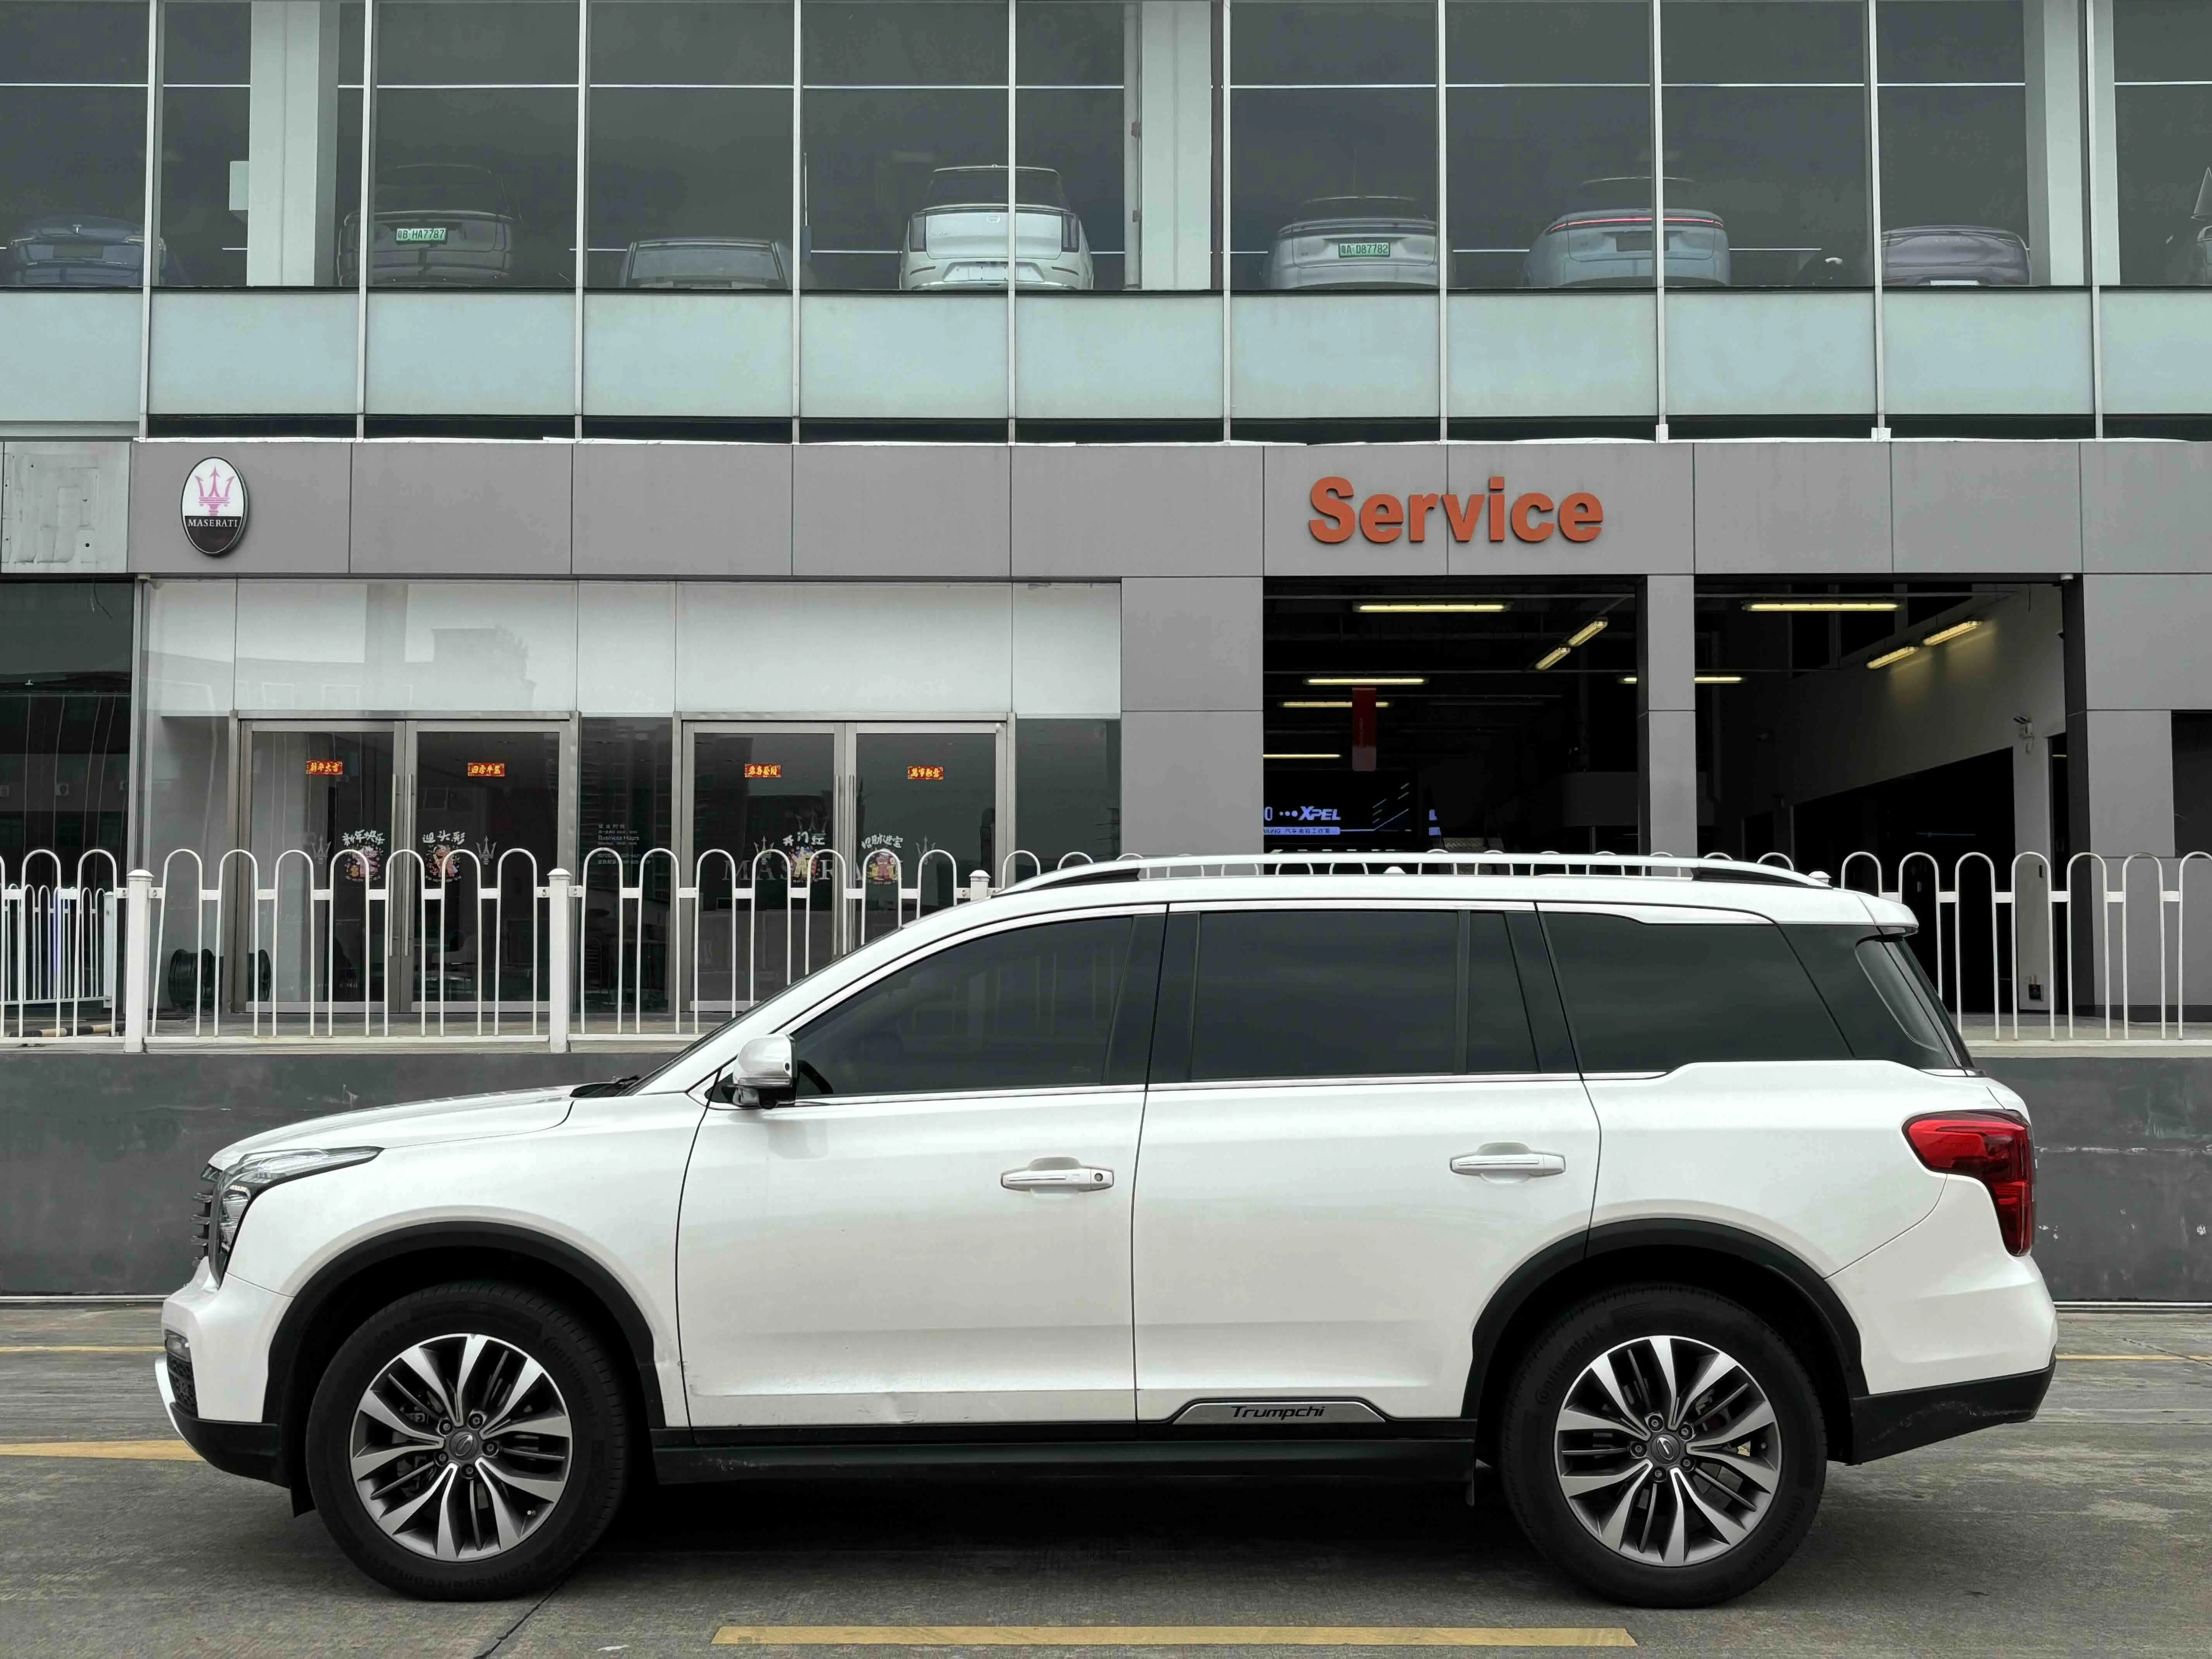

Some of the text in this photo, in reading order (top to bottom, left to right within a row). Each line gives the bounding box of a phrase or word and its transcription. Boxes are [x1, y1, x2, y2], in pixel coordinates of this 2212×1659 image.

[1309, 476, 1603, 544] Service
[188, 519, 237, 527] MASERATI
[1298, 806, 1341, 821] XPEL
[342, 829, 385, 846] 新年快乐
[783, 831, 826, 846] 开门红
[1231, 1406, 1325, 1420] Trumpchi
